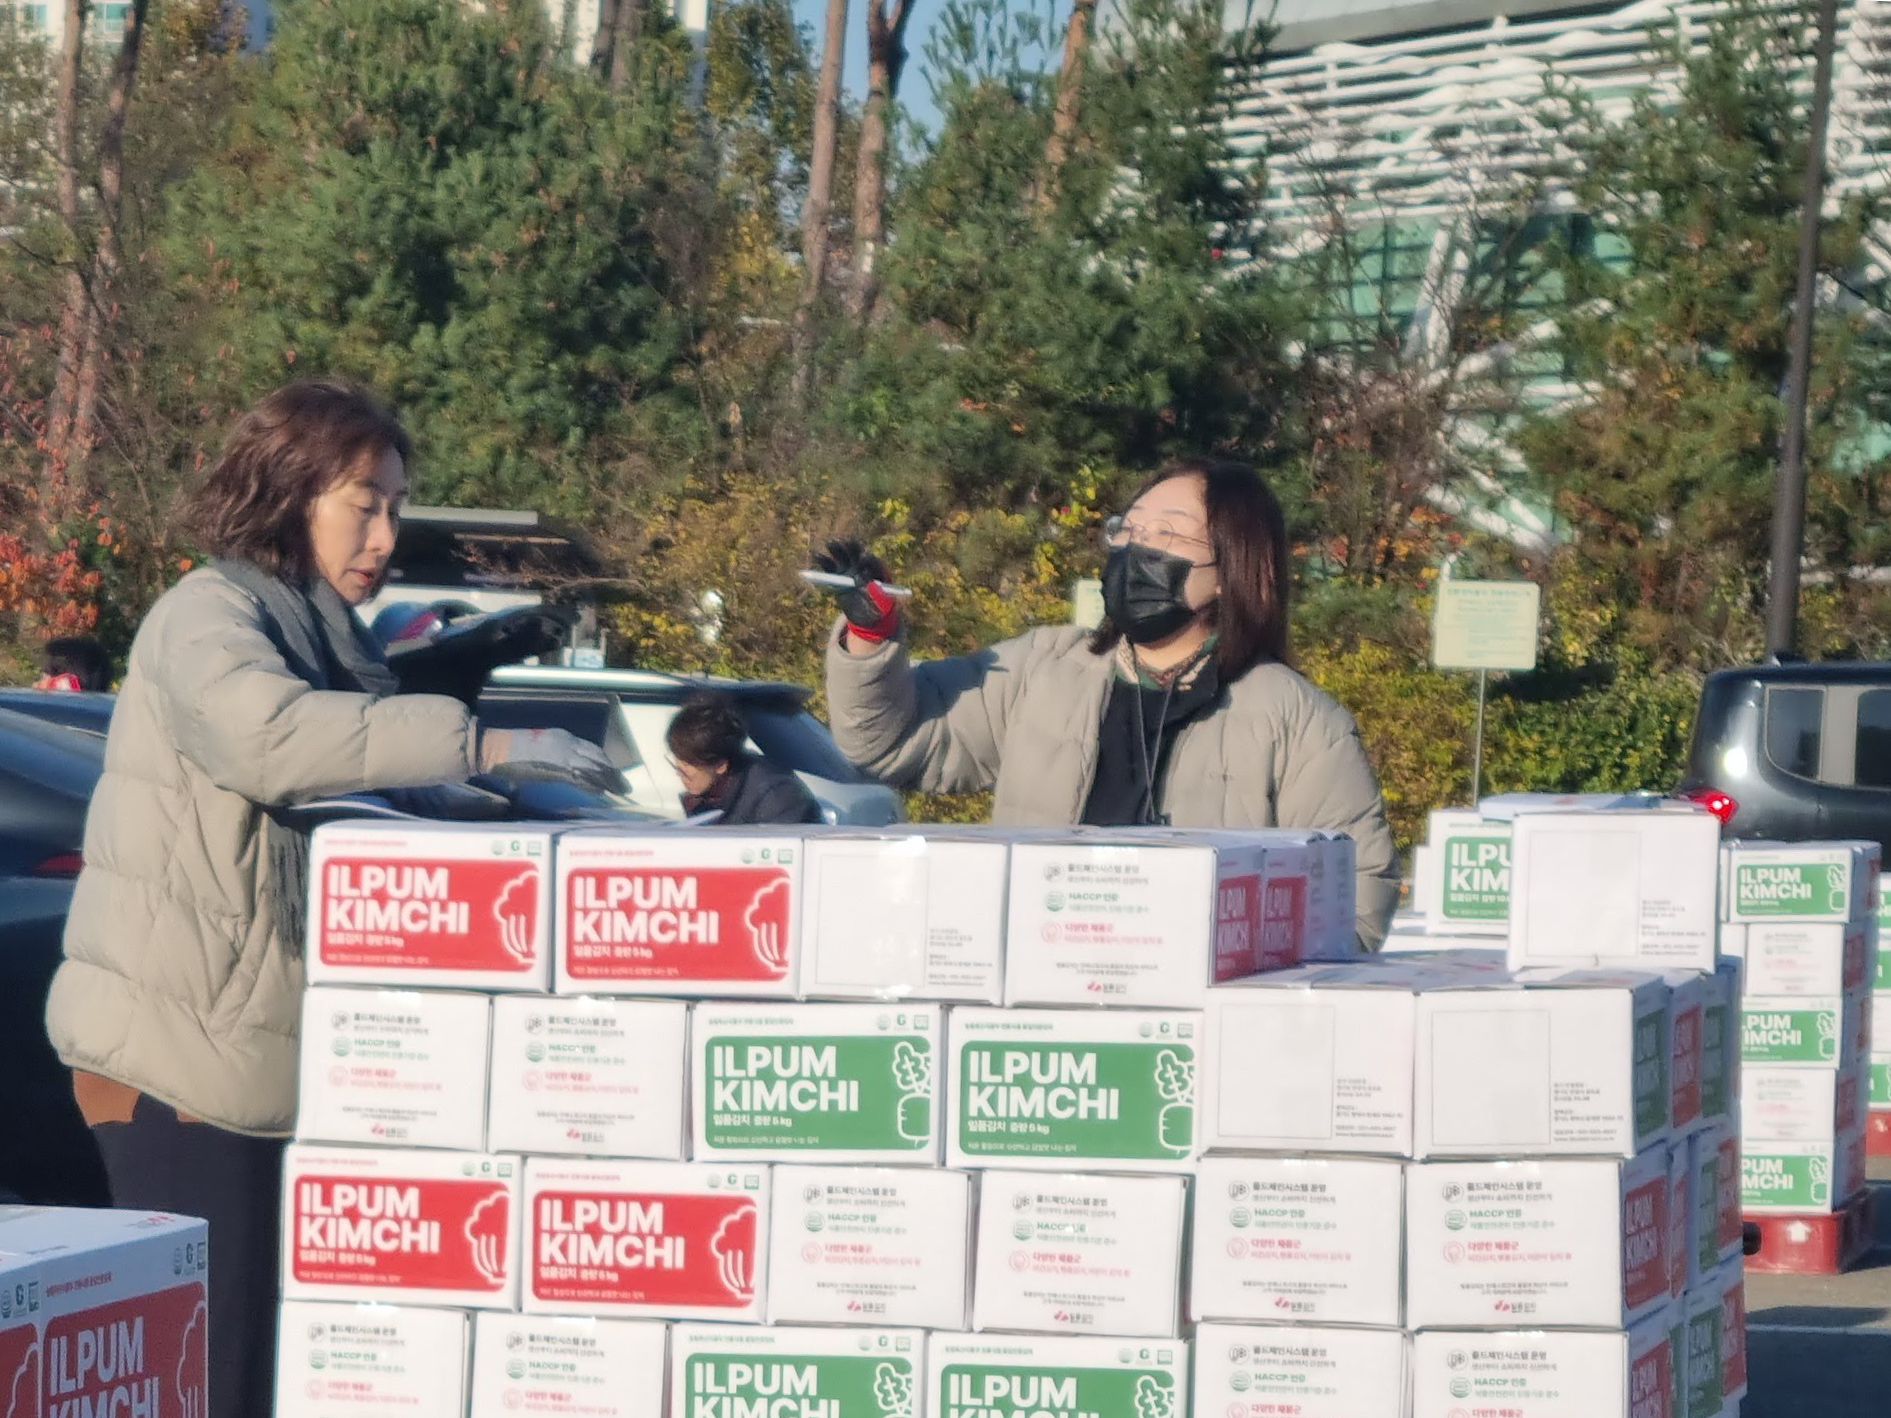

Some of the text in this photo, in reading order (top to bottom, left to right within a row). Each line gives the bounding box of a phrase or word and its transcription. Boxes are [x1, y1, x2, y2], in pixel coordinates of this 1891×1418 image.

[1452, 843, 1511, 867] ILPU
[328, 864, 448, 900] ILPUM
[1450, 867, 1510, 892] KIM
[1740, 867, 1801, 883] ILPUM
[1740, 883, 1812, 899] KIMCHI
[573, 876, 697, 910] ILPUM
[327, 899, 468, 933] KIMCHI
[573, 910, 718, 943] KIMCHI
[1744, 1030, 1802, 1045] IMCHI
[1747, 1015, 1791, 1029] PUM
[713, 1045, 836, 1078] ILPUM
[969, 1050, 1096, 1085] ILPUM
[713, 1079, 858, 1112] KIMCHI
[968, 1085, 1119, 1119] KIMCHI
[1742, 1159, 1783, 1174] PUM
[1742, 1174, 1794, 1189] MCHI
[300, 1182, 419, 1219] ILPUM
[540, 1198, 663, 1234] ILPUM
[300, 1216, 440, 1253] KIMCHI
[540, 1232, 684, 1268] KIMCHI
[49, 1315, 143, 1396] ILPUM
[693, 1362, 817, 1396] ILPUM
[948, 1373, 1076, 1409] ILPUM
